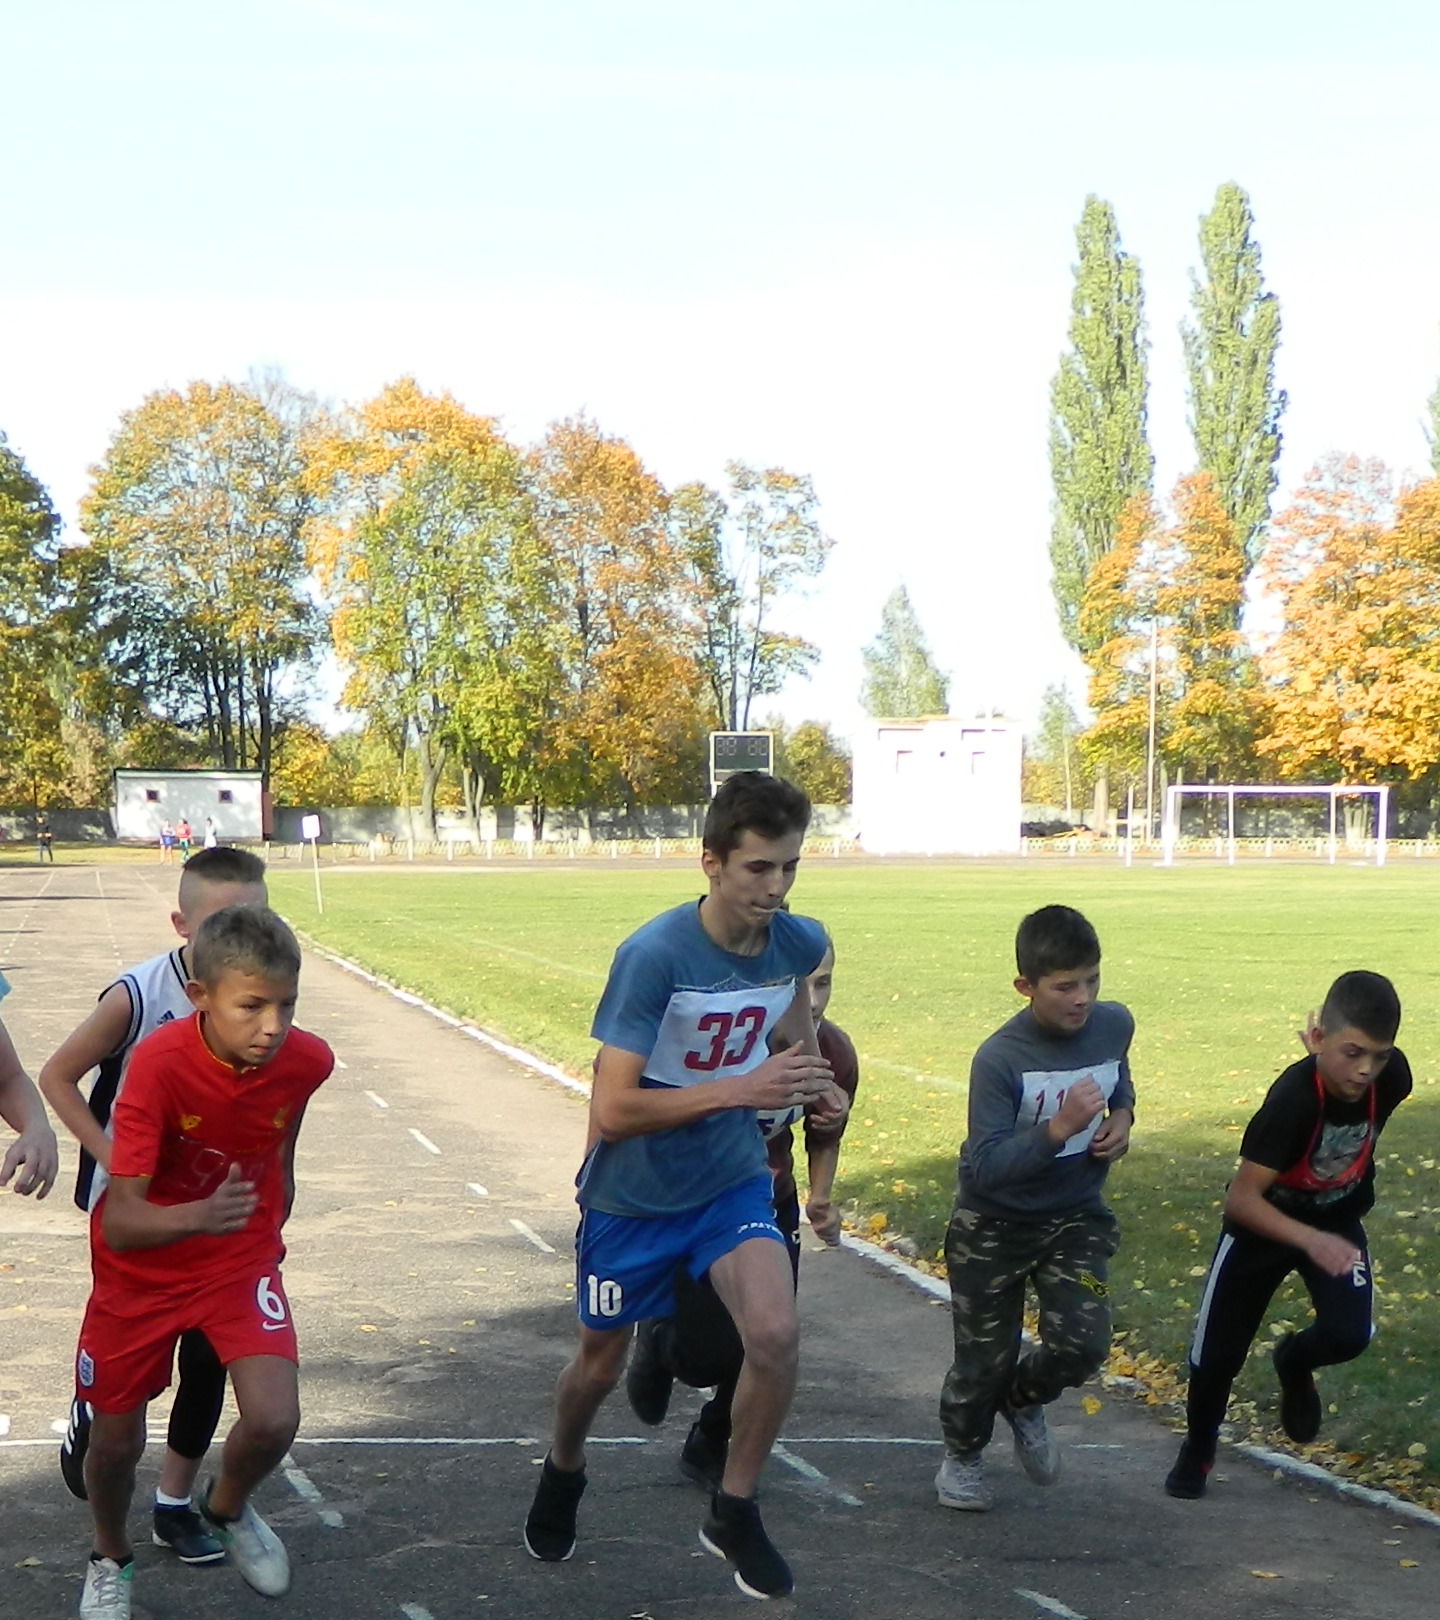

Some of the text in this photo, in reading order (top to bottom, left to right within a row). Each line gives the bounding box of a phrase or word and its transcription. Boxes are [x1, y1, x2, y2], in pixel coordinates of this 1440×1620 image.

[684, 1006, 767, 1071] 33
[256, 1276, 286, 1321] 6
[586, 1274, 623, 1317] 10
